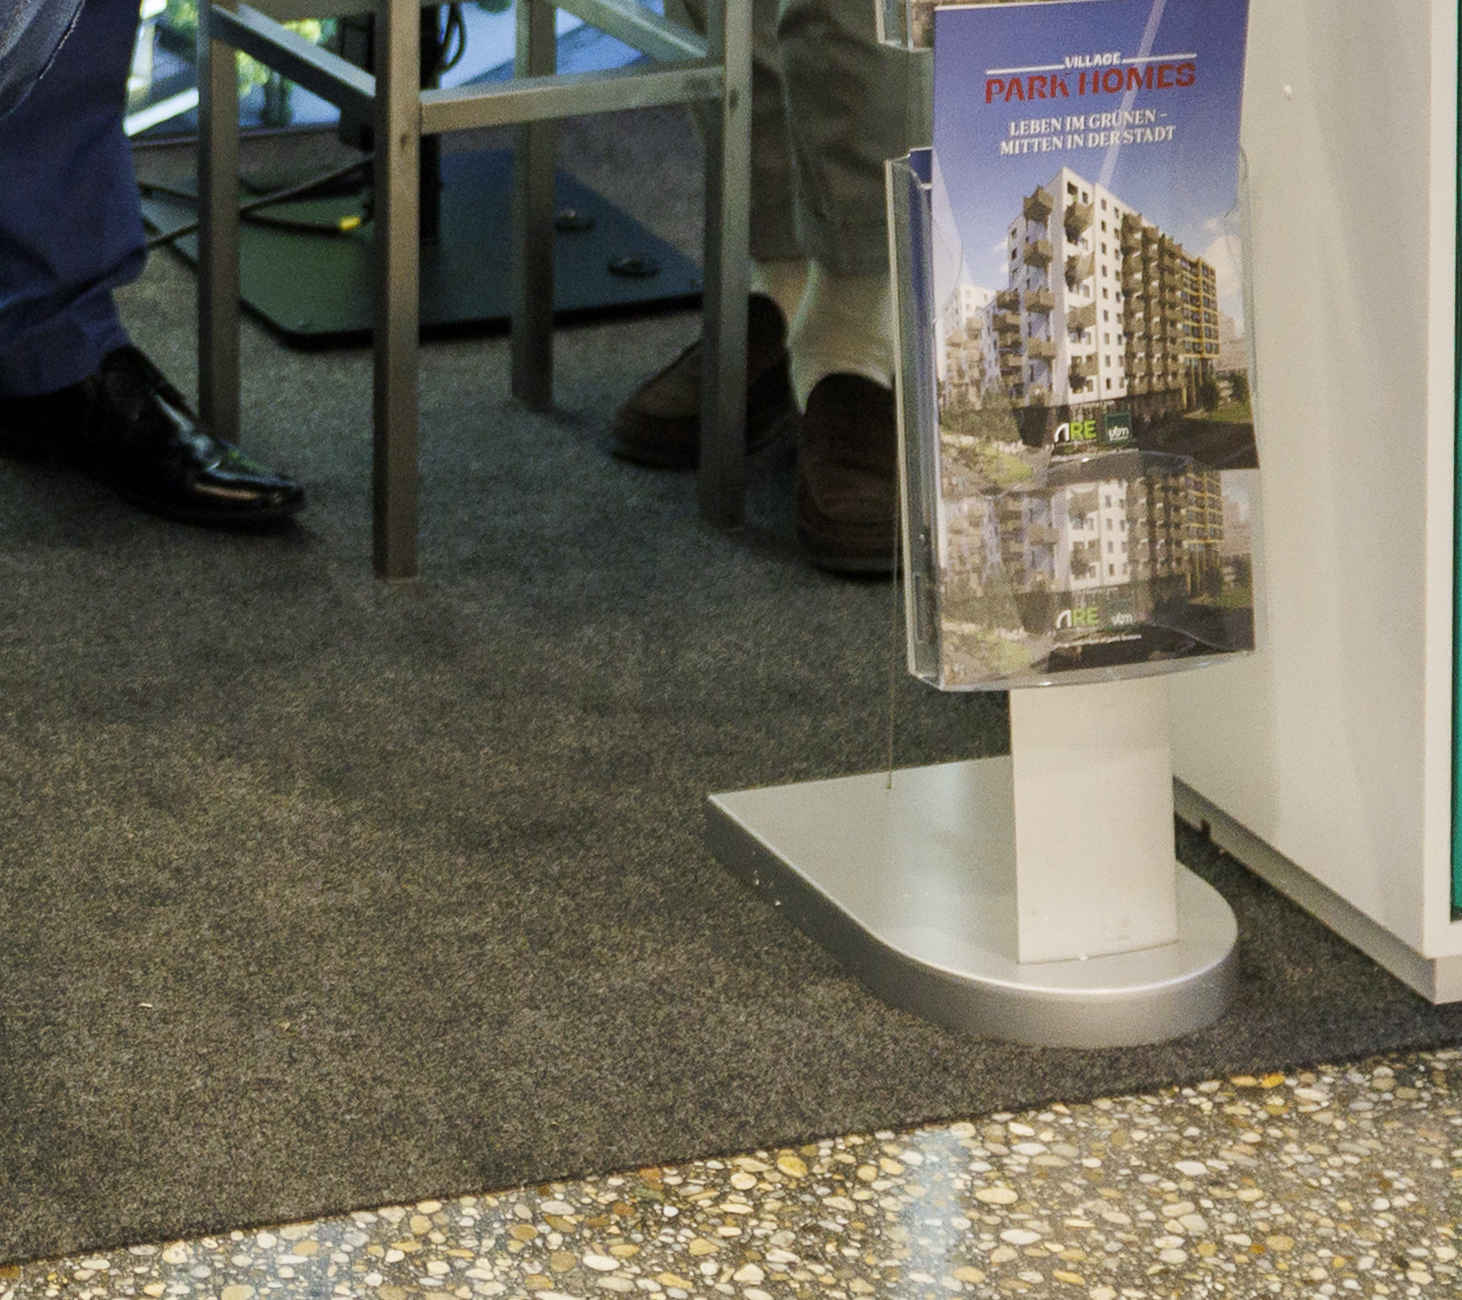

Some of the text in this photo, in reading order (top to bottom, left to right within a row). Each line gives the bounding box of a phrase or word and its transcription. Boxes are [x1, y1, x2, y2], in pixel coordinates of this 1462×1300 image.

[1064, 52, 1122, 68] VILLAGE
[984, 62, 1197, 105] PARK HOMES
[1008, 115, 1062, 137] LEBEN
[1064, 114, 1085, 132] IM
[1086, 106, 1157, 130] GRÜNEN
[999, 123, 1177, 156] MITTEN IN DER STADT
